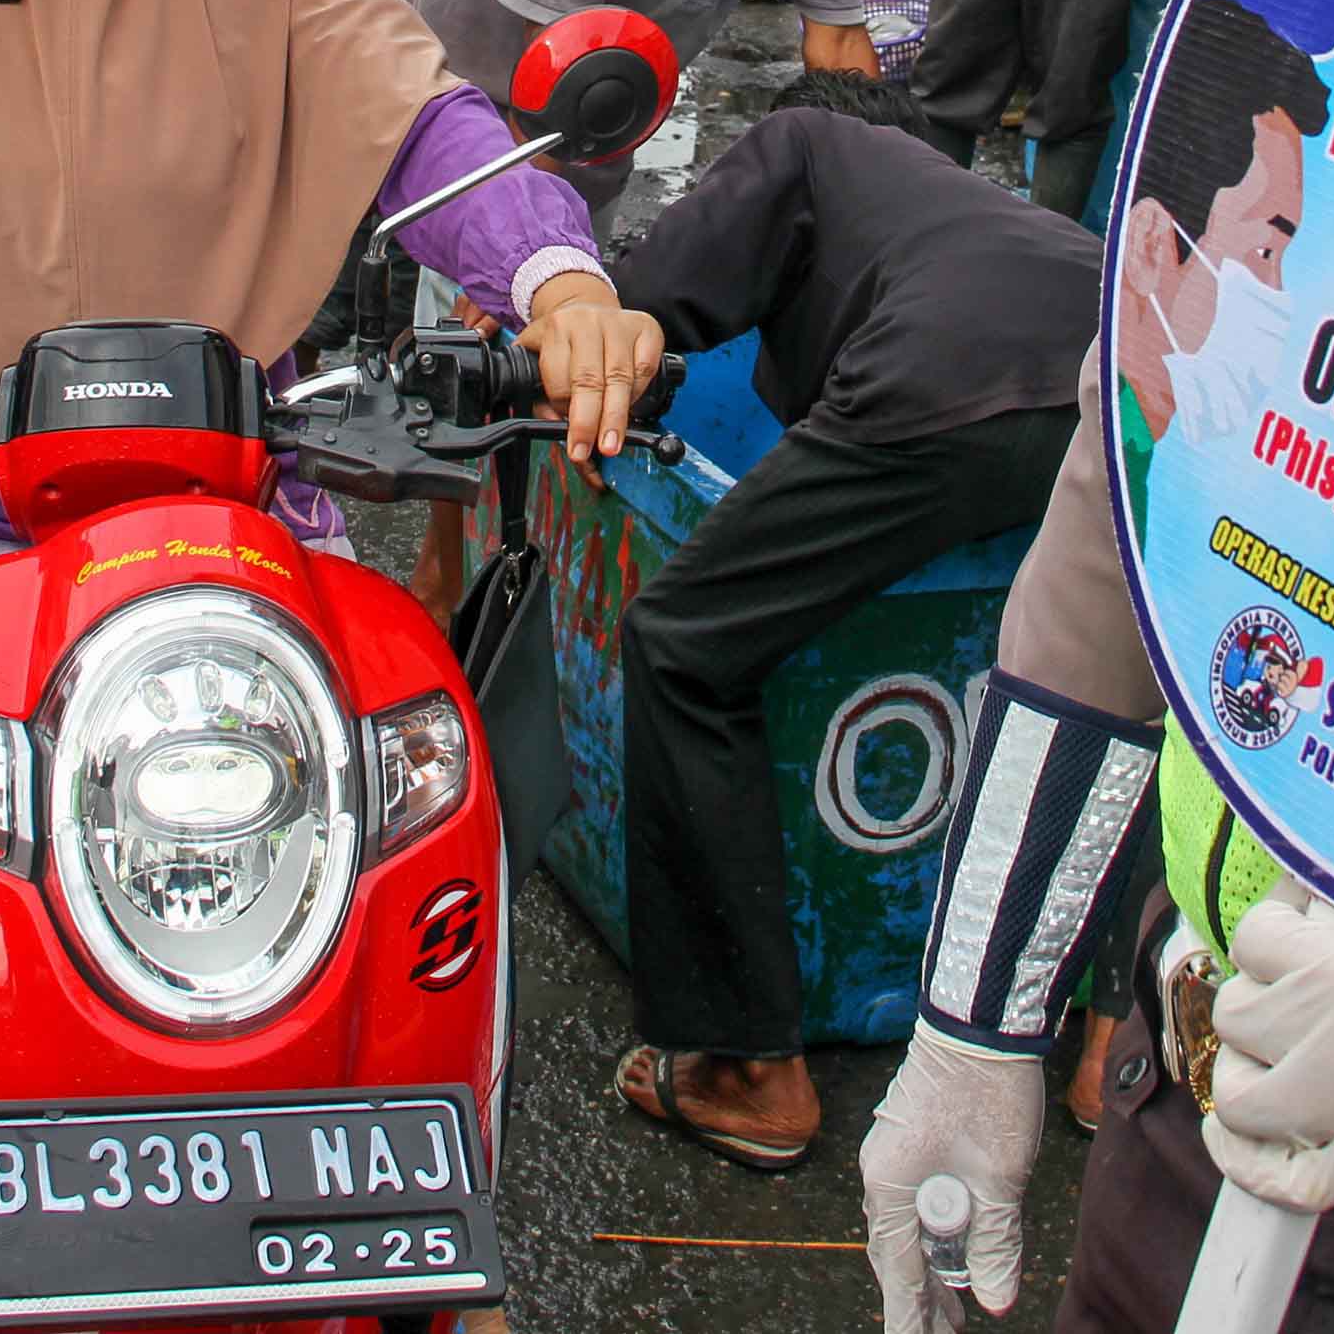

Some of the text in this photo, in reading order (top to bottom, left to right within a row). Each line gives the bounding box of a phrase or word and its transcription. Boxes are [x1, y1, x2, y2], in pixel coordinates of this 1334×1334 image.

[63, 381, 174, 402] HONDA
[76, 538, 294, 585] Campion Honda Motor
[1210, 517, 1301, 599] OPERASI
[310, 1120, 454, 1199] NAJ
